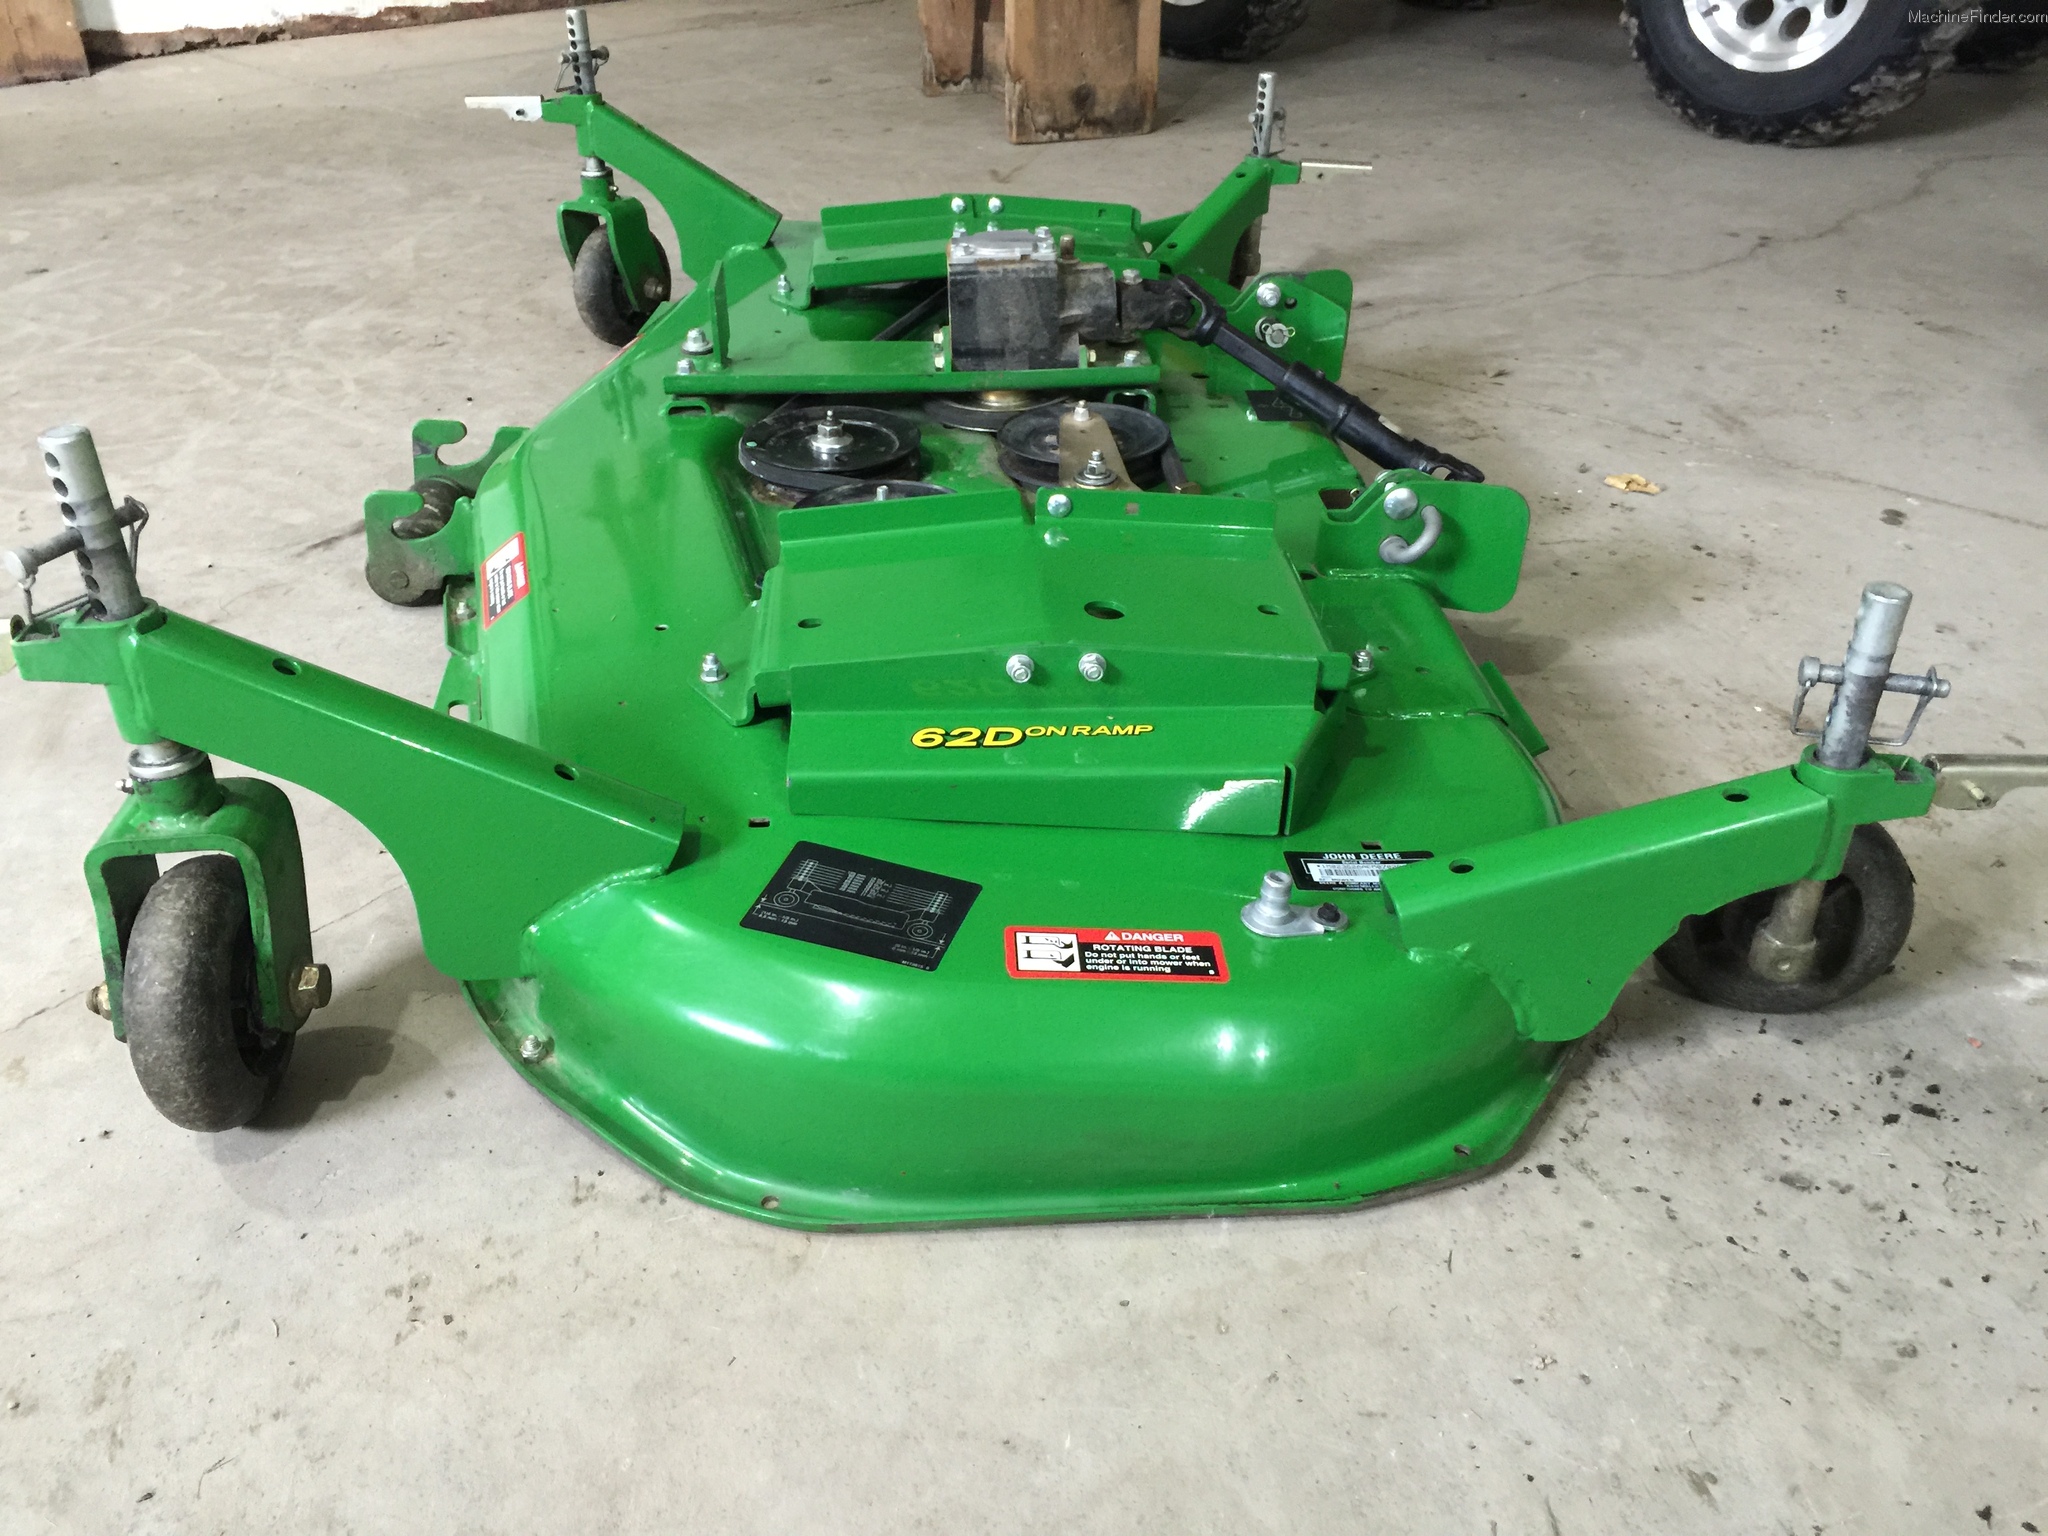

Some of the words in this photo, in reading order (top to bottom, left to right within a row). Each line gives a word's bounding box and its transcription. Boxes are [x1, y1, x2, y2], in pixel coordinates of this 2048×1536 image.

[911, 726, 1026, 749] 62D
[1025, 725, 1068, 737] ON
[1071, 724, 1155, 737] RAMP
[1323, 852, 1356, 860] JOHN
[1360, 852, 1402, 860] DEERE
[1121, 932, 1184, 942] DANGER
[1092, 944, 1152, 953] ROTATING
[1154, 946, 1193, 954] BLADE
[1137, 952, 1168, 960] hands
[1132, 965, 1172, 973] running
